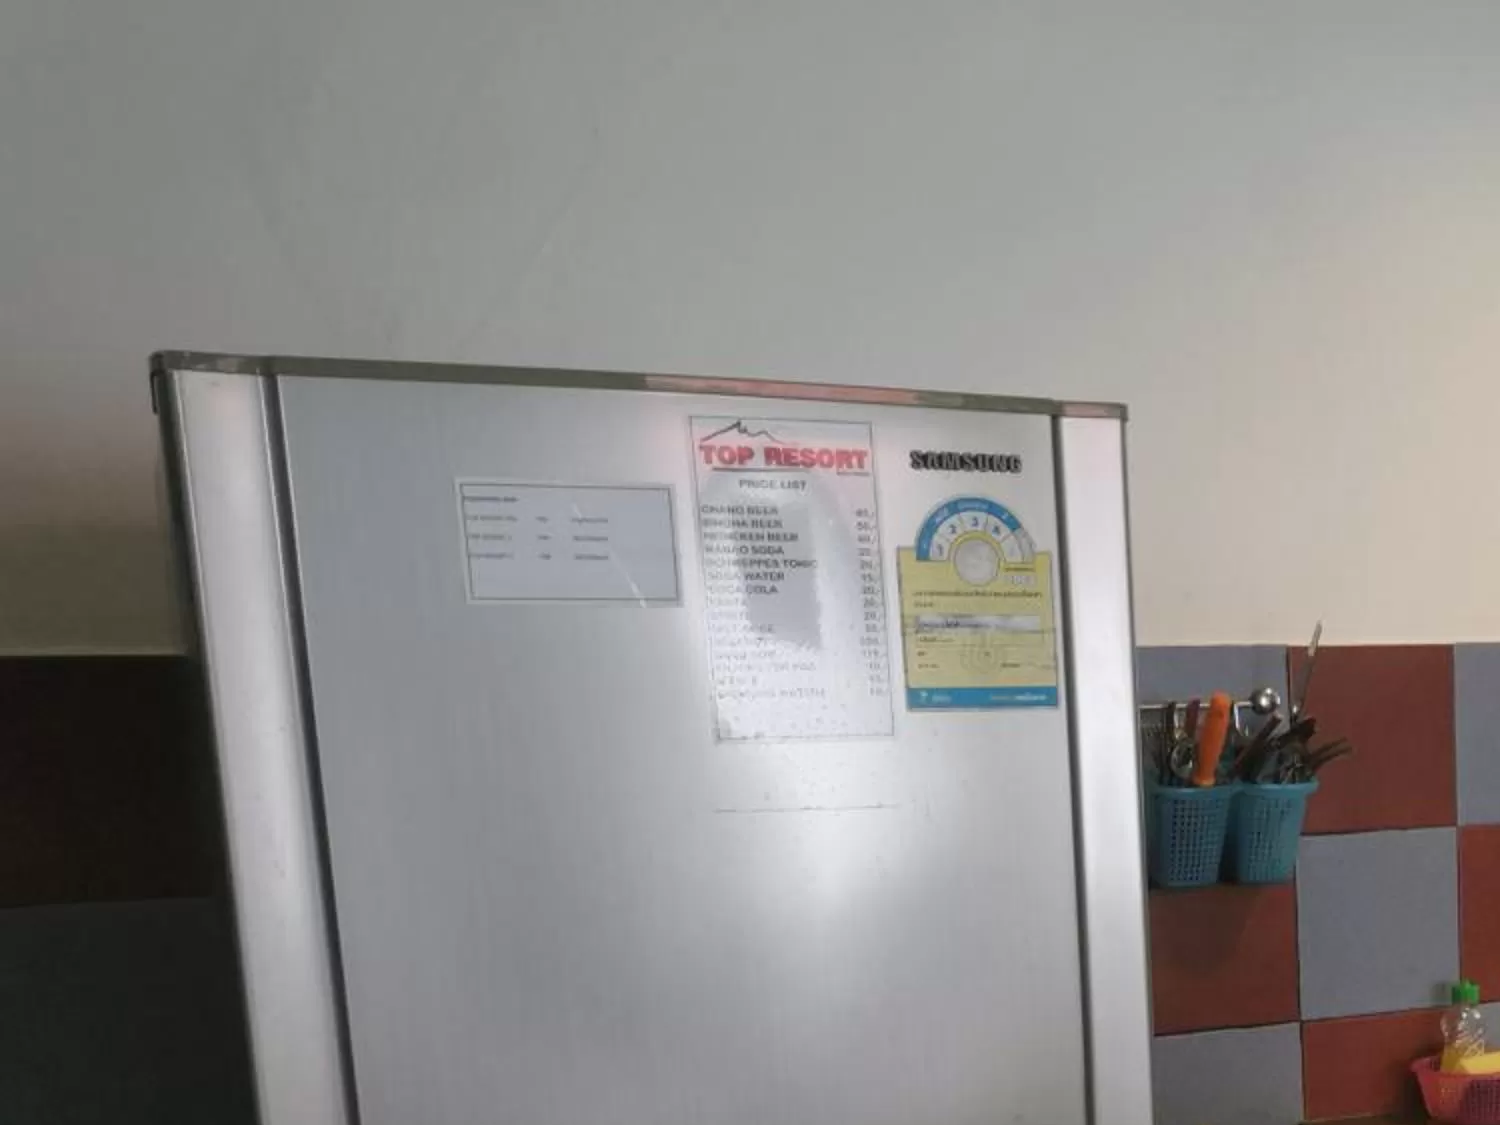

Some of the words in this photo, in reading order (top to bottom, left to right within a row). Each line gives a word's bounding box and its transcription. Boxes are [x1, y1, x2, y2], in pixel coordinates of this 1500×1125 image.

[699, 444, 755, 467] TOP
[764, 447, 869, 470] RESORT
[910, 450, 1022, 473] SAMSUNG
[739, 479, 776, 490] PRICE
[780, 480, 807, 491] LIST
[751, 545, 785, 556] SODA
[744, 571, 785, 582] WATER
